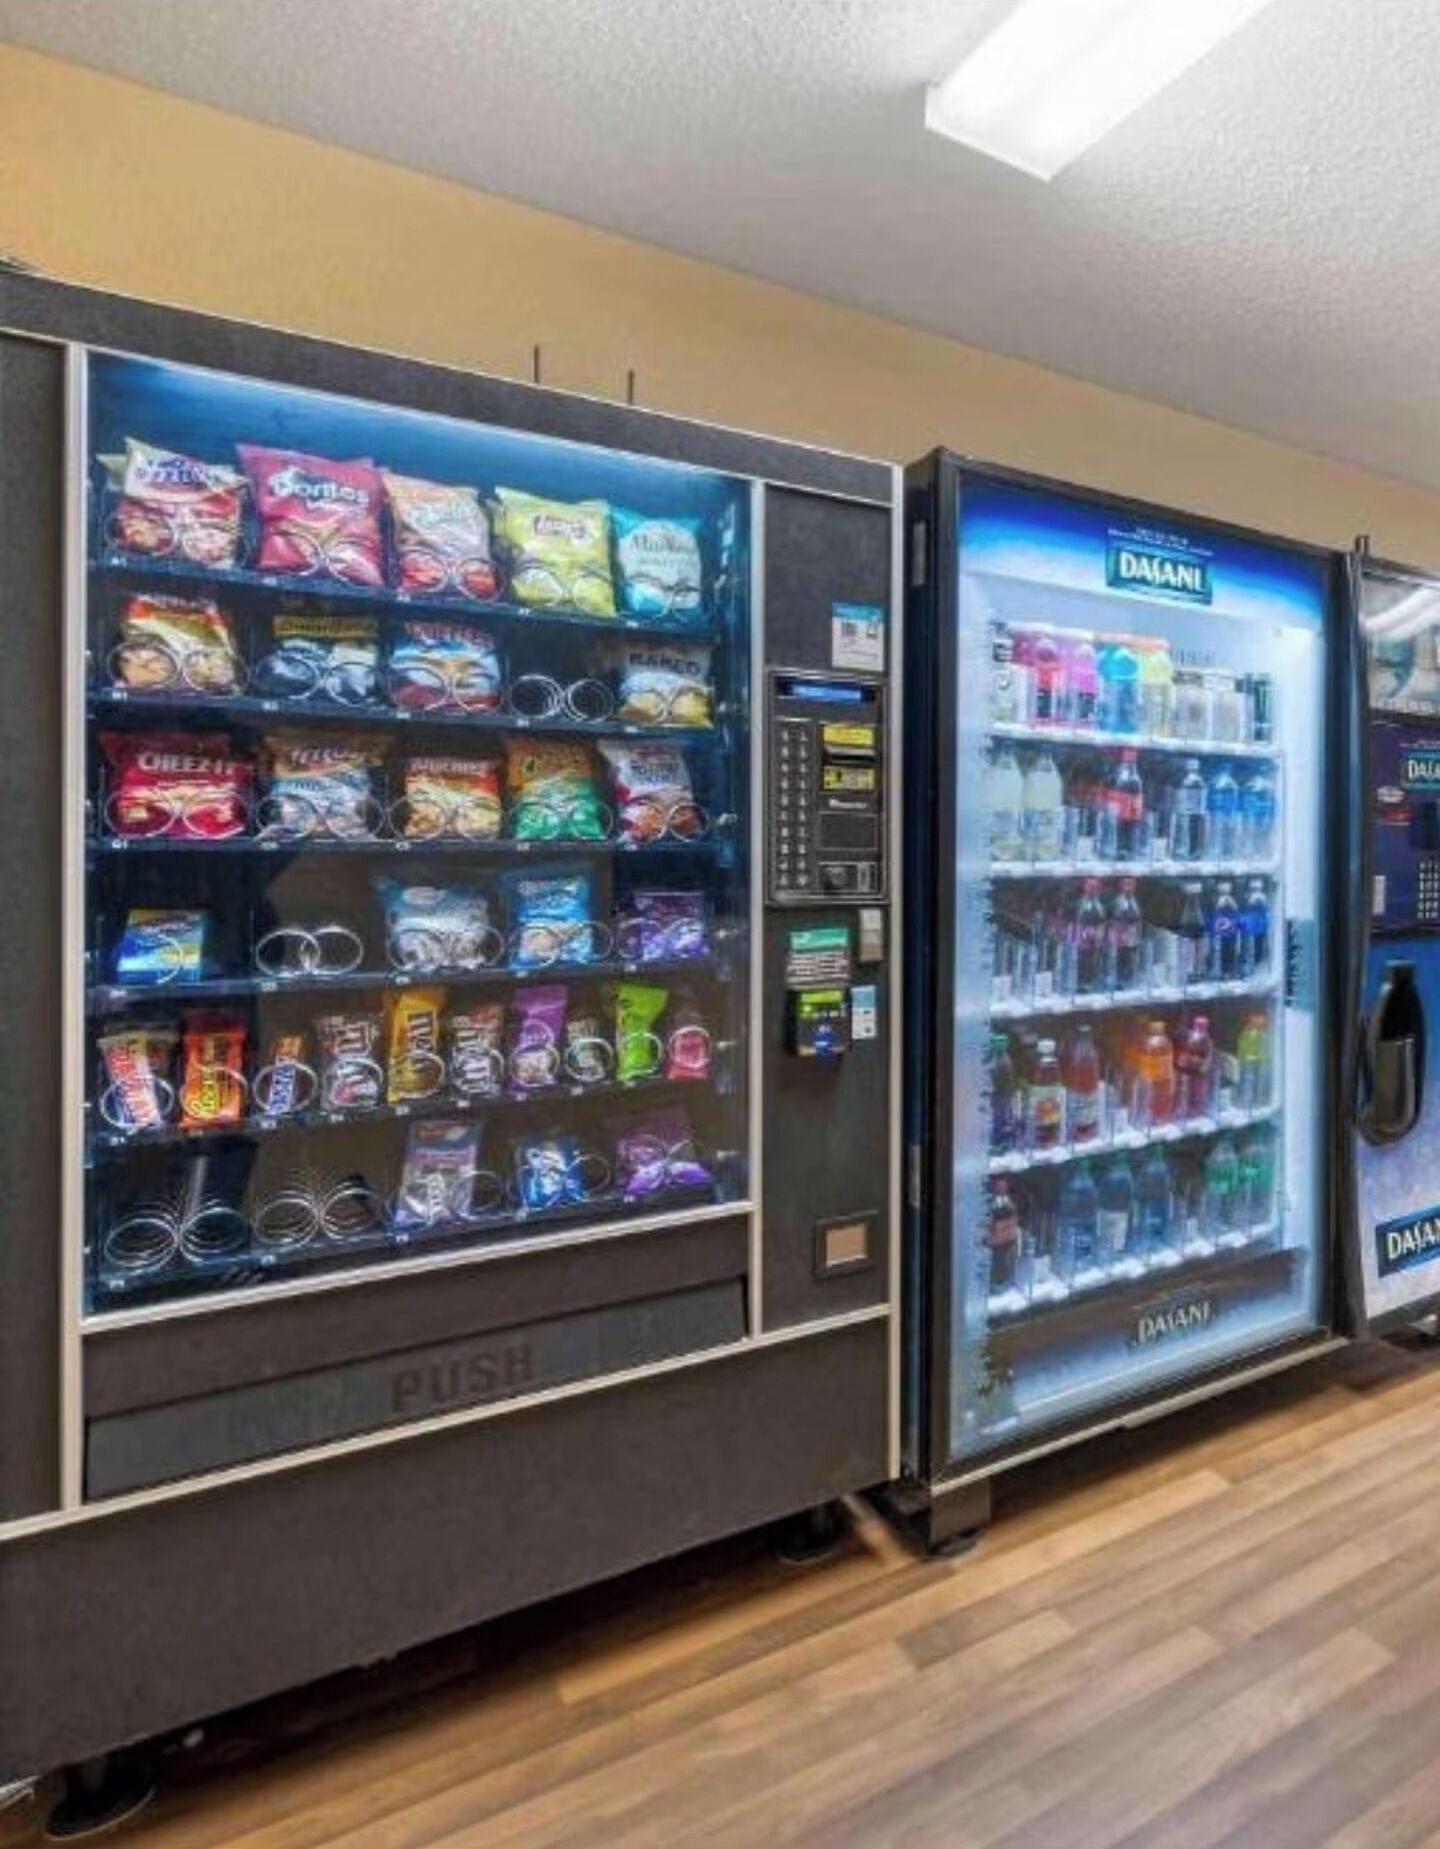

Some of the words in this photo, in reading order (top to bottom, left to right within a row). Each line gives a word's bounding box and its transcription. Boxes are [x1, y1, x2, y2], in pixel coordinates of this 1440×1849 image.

[1120, 550, 1203, 593] DASANI
[1137, 1300, 1211, 1344] DASANI
[392, 1344, 534, 1413] PUSH
